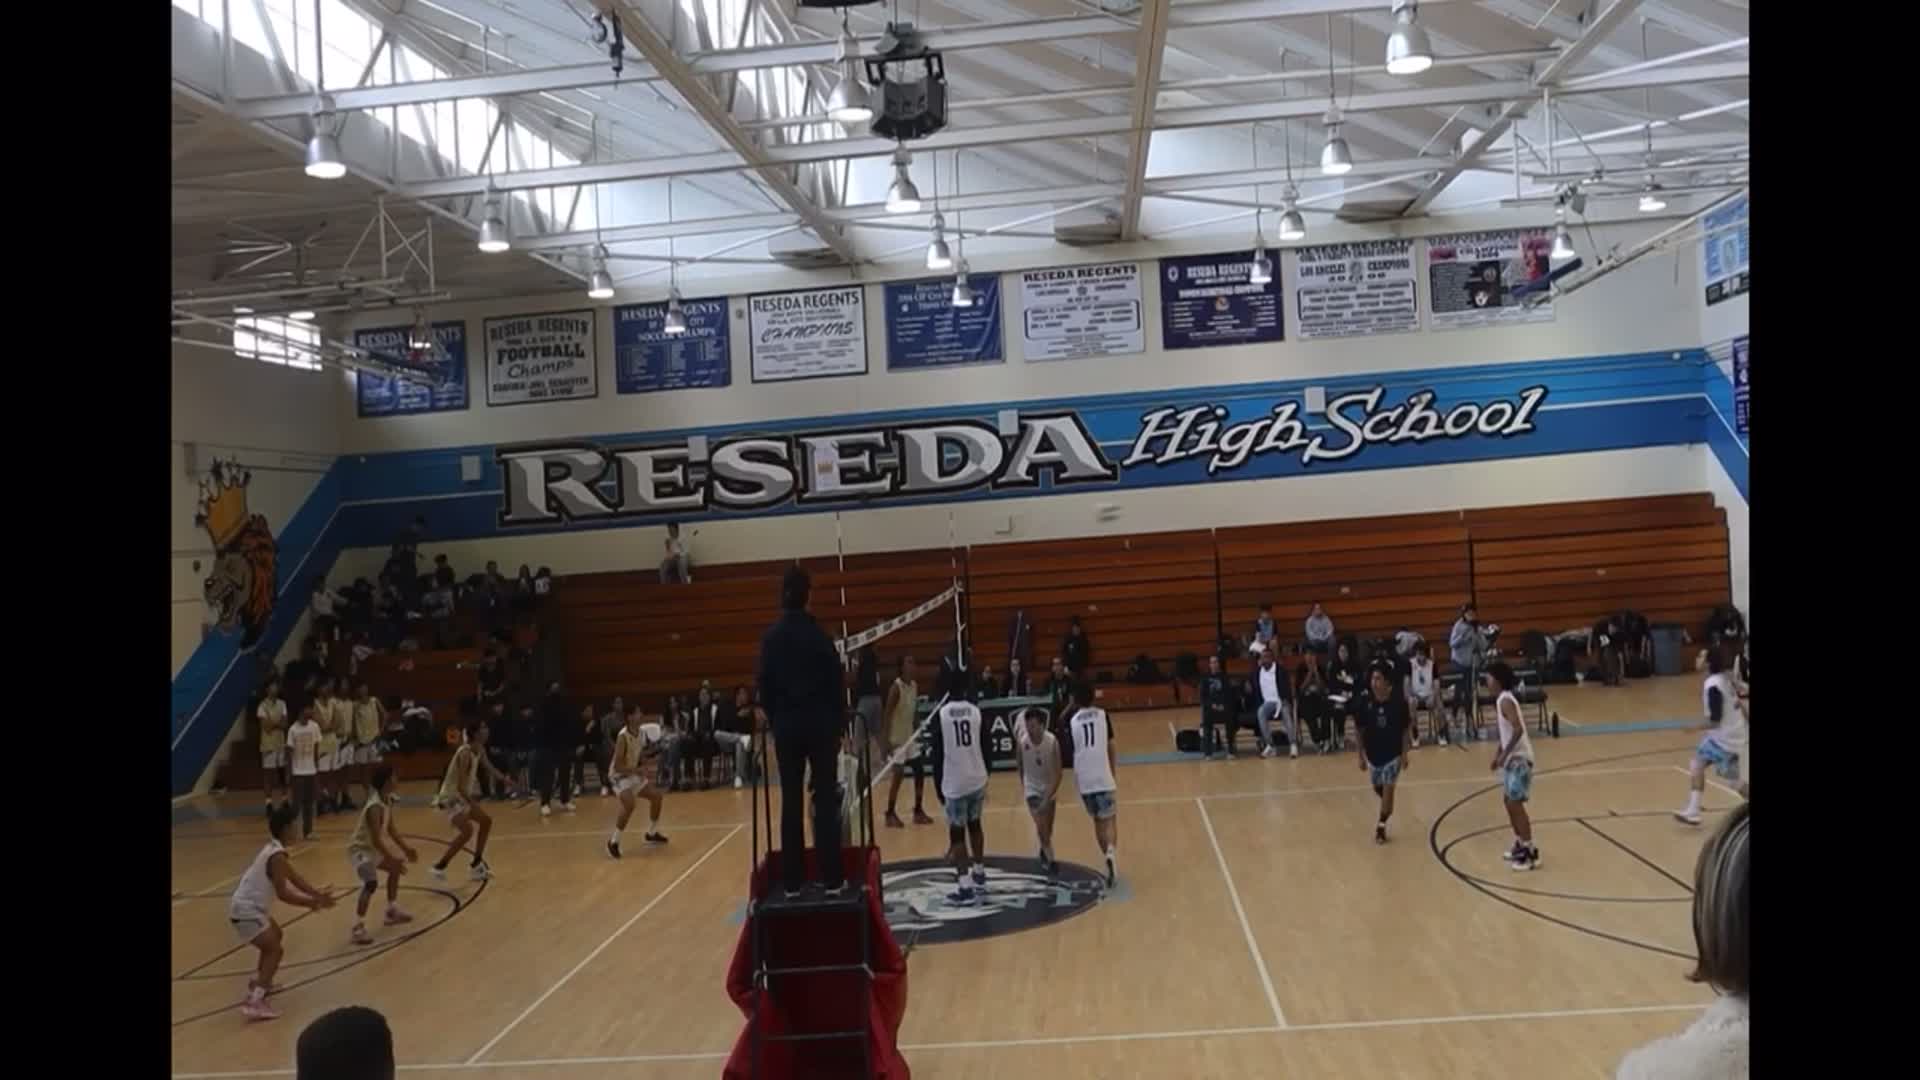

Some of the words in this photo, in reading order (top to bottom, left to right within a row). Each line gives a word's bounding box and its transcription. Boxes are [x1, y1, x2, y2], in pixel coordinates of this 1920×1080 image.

[1023, 268, 1074, 282] RESEDA
[1077, 264, 1137, 279] REGENTS
[621, 307, 665, 321] RESEDA
[682, 303, 721, 316] GENTS
[753, 295, 802, 313] RESEDA
[803, 290, 860, 309] REGENTS
[489, 319, 533, 342] RESEDA
[537, 316, 591, 335] REGENTS
[761, 320, 854, 343] CHAMPIONS
[497, 342, 586, 366] FOOTBALL
[507, 359, 575, 379] Champs
[497, 411, 1120, 527] RESEDA
[1121, 399, 1311, 475] High
[1301, 384, 1551, 465] School
[952, 719, 972, 748] 18
[1082, 720, 1095, 748] 11
